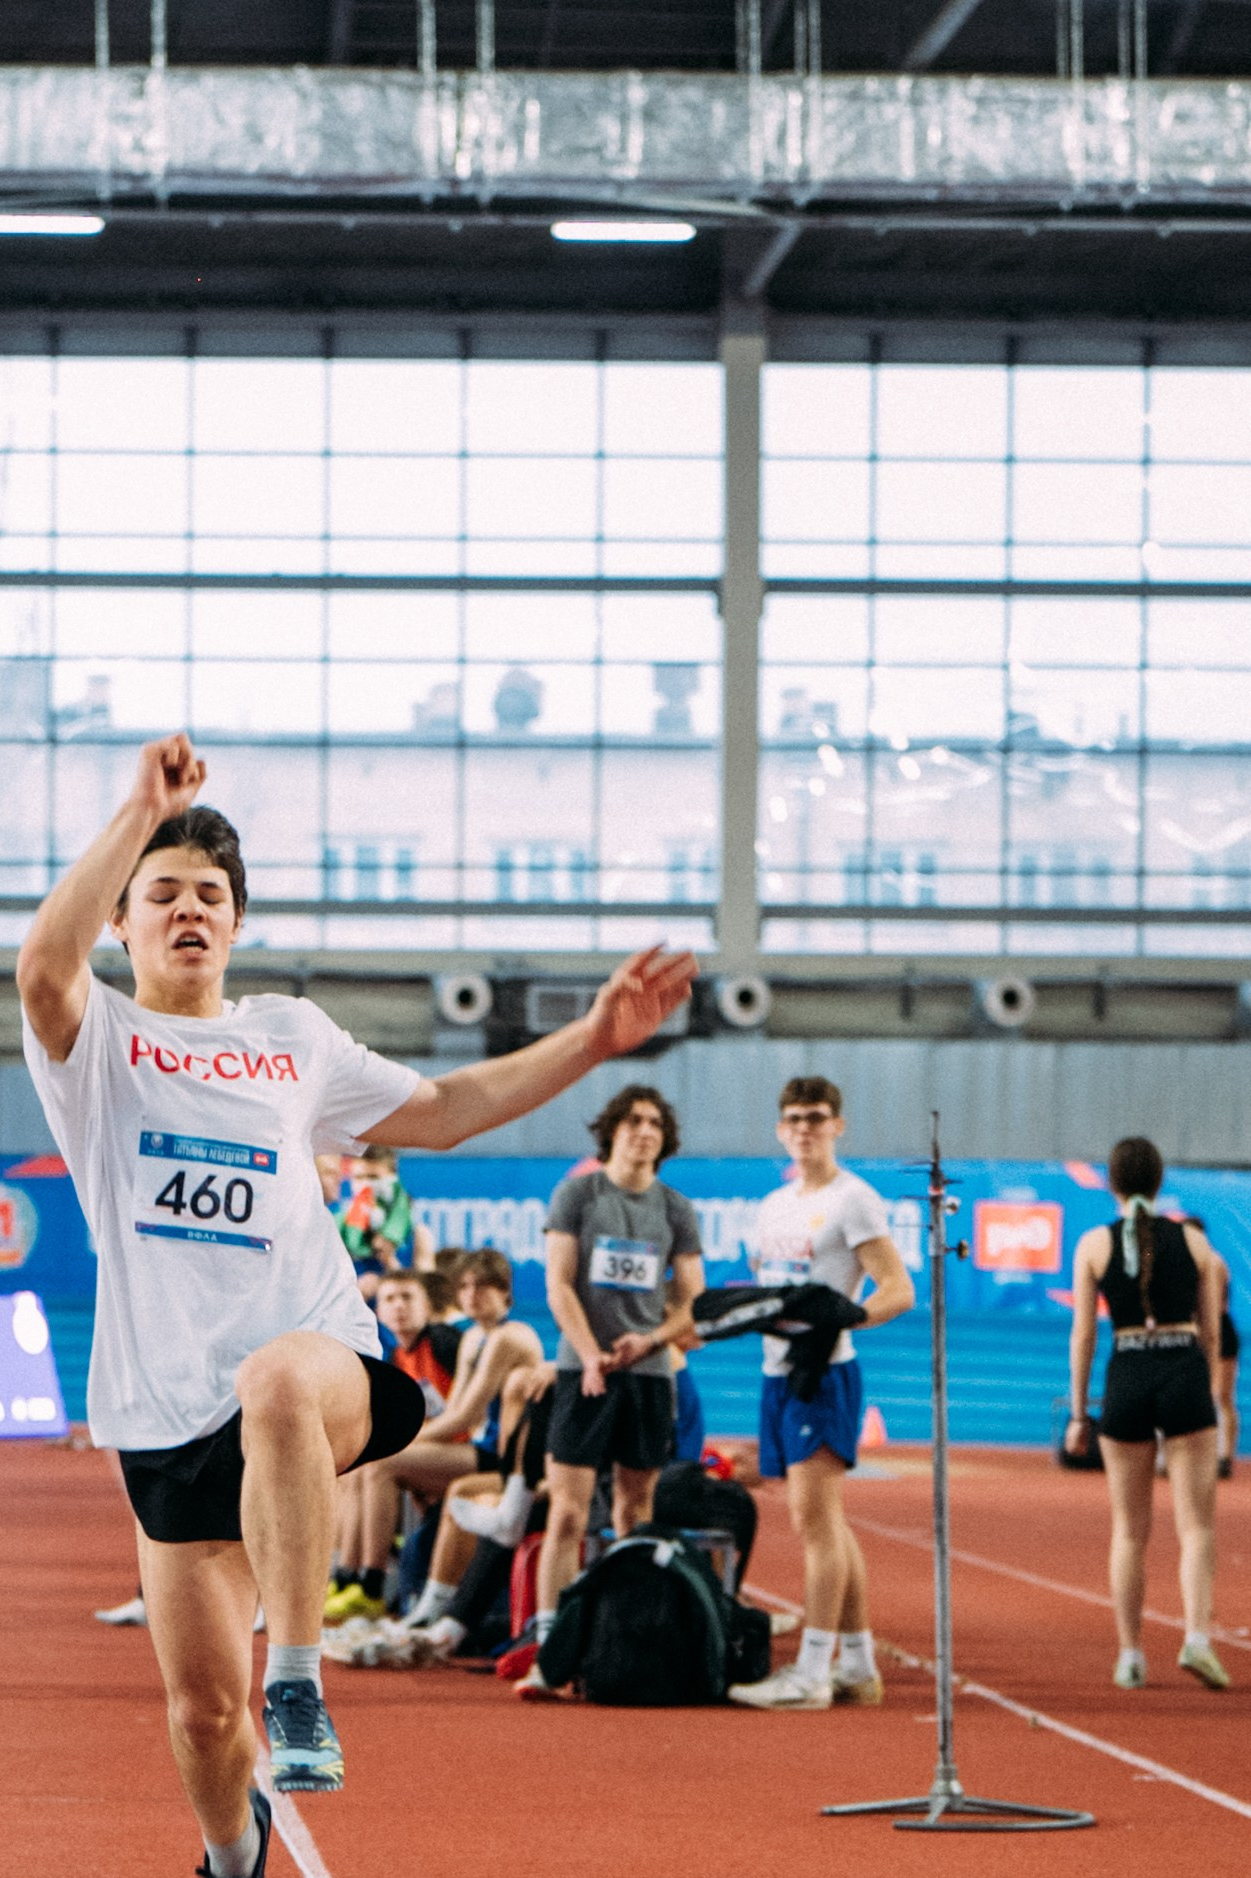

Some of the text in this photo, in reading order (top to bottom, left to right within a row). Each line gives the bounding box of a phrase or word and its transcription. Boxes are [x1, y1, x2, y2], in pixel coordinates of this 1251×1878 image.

[131, 1034, 299, 1081] РОССИЯ
[155, 1170, 254, 1224] 460
[604, 1255, 646, 1281] 396
